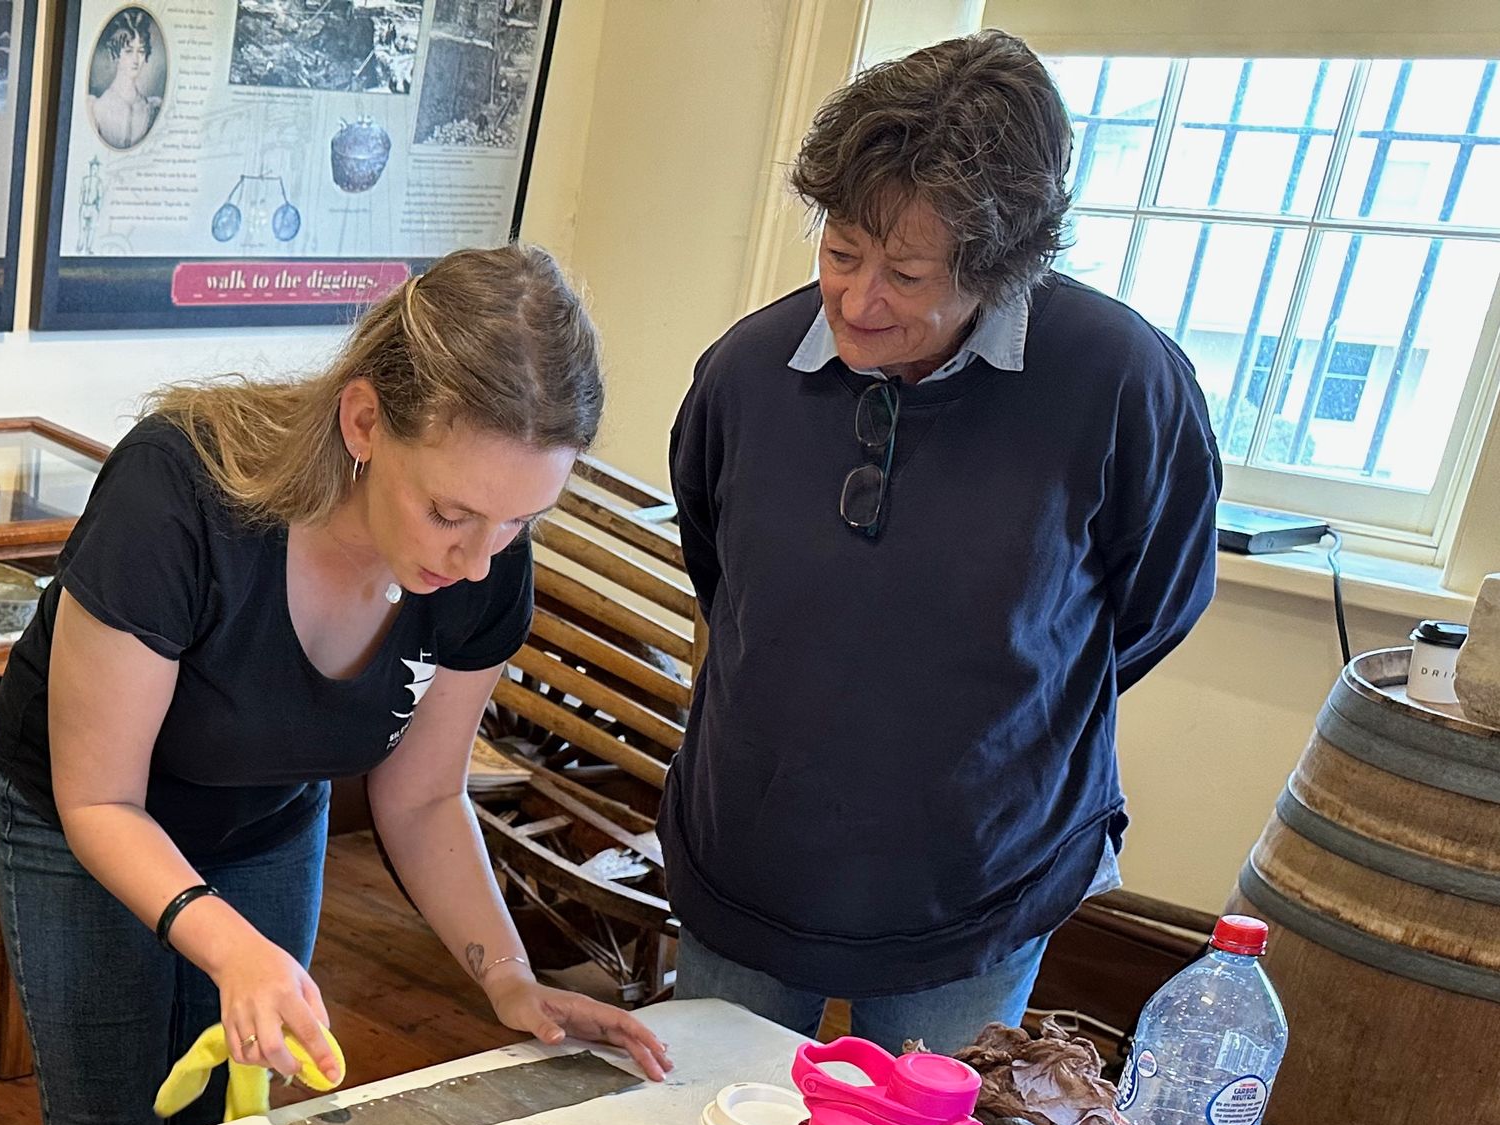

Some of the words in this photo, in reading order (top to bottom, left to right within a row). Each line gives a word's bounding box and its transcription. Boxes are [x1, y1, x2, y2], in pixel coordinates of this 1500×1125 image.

[206, 269, 247, 289] walk
[252, 270, 270, 289] to
[274, 269, 302, 289] the
[306, 269, 379, 293] diggings.
